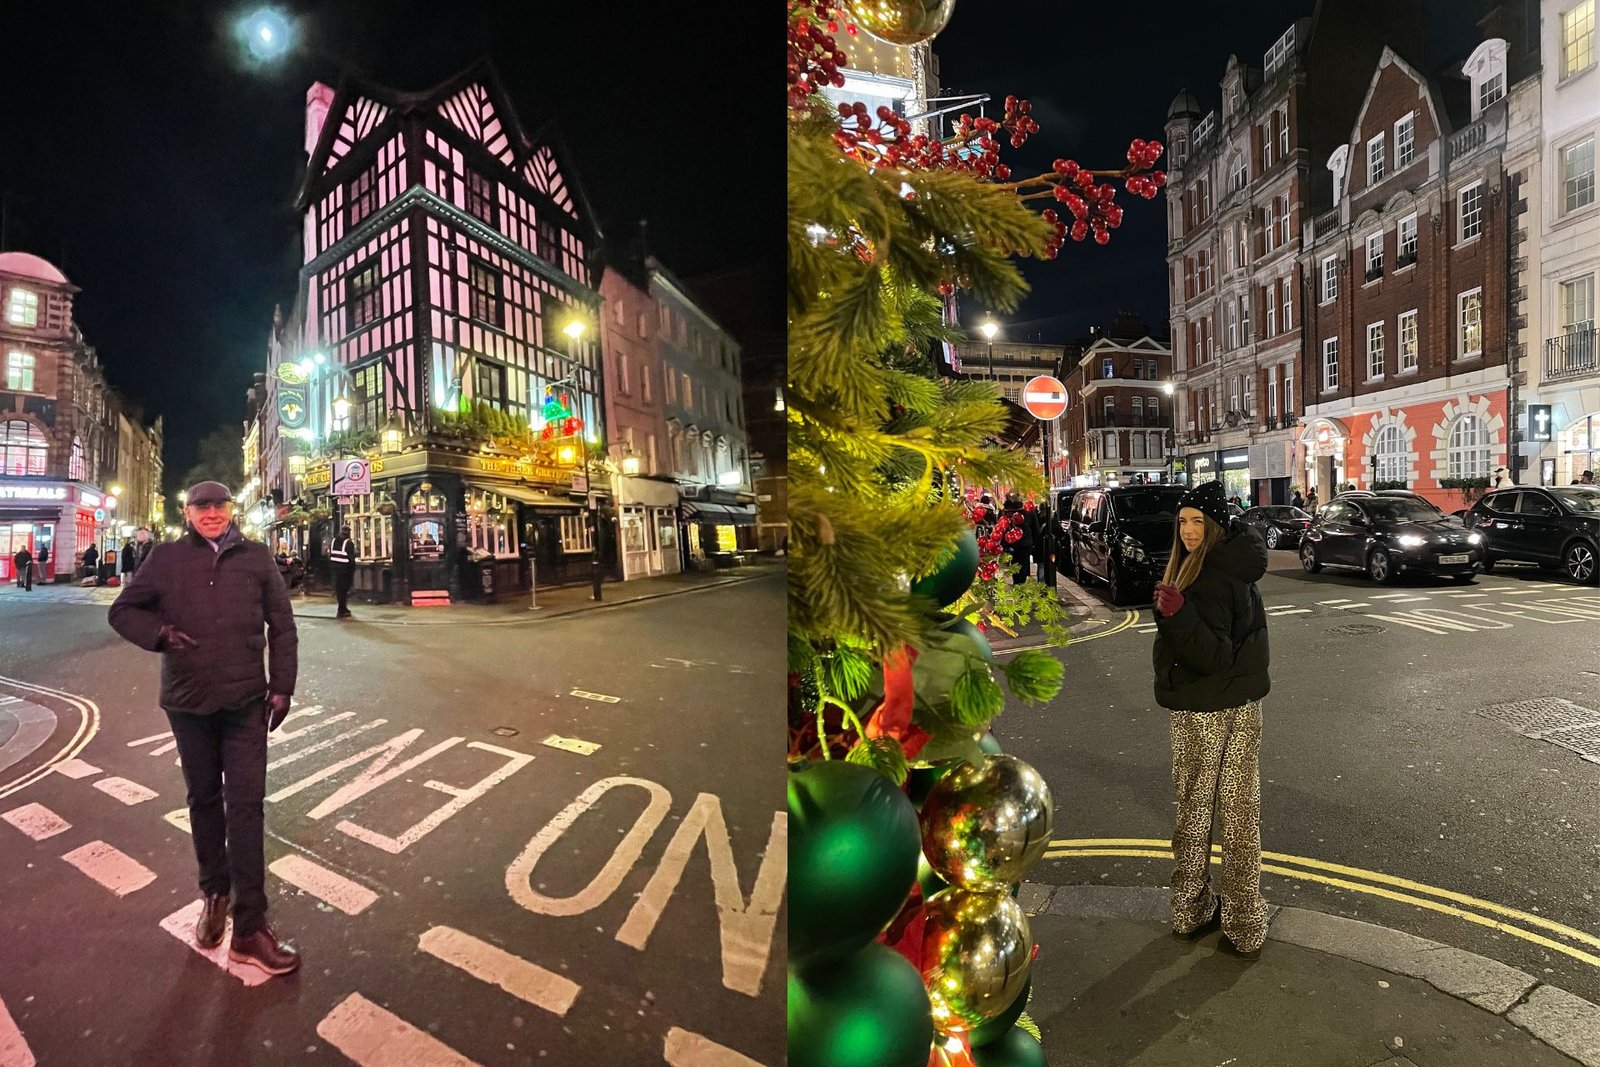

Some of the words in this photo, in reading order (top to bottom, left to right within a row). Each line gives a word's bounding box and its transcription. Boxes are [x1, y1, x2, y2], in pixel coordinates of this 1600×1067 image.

[481, 459, 500, 471] THE
[1364, 608, 1514, 635] NO
[505, 776, 787, 997] NO
